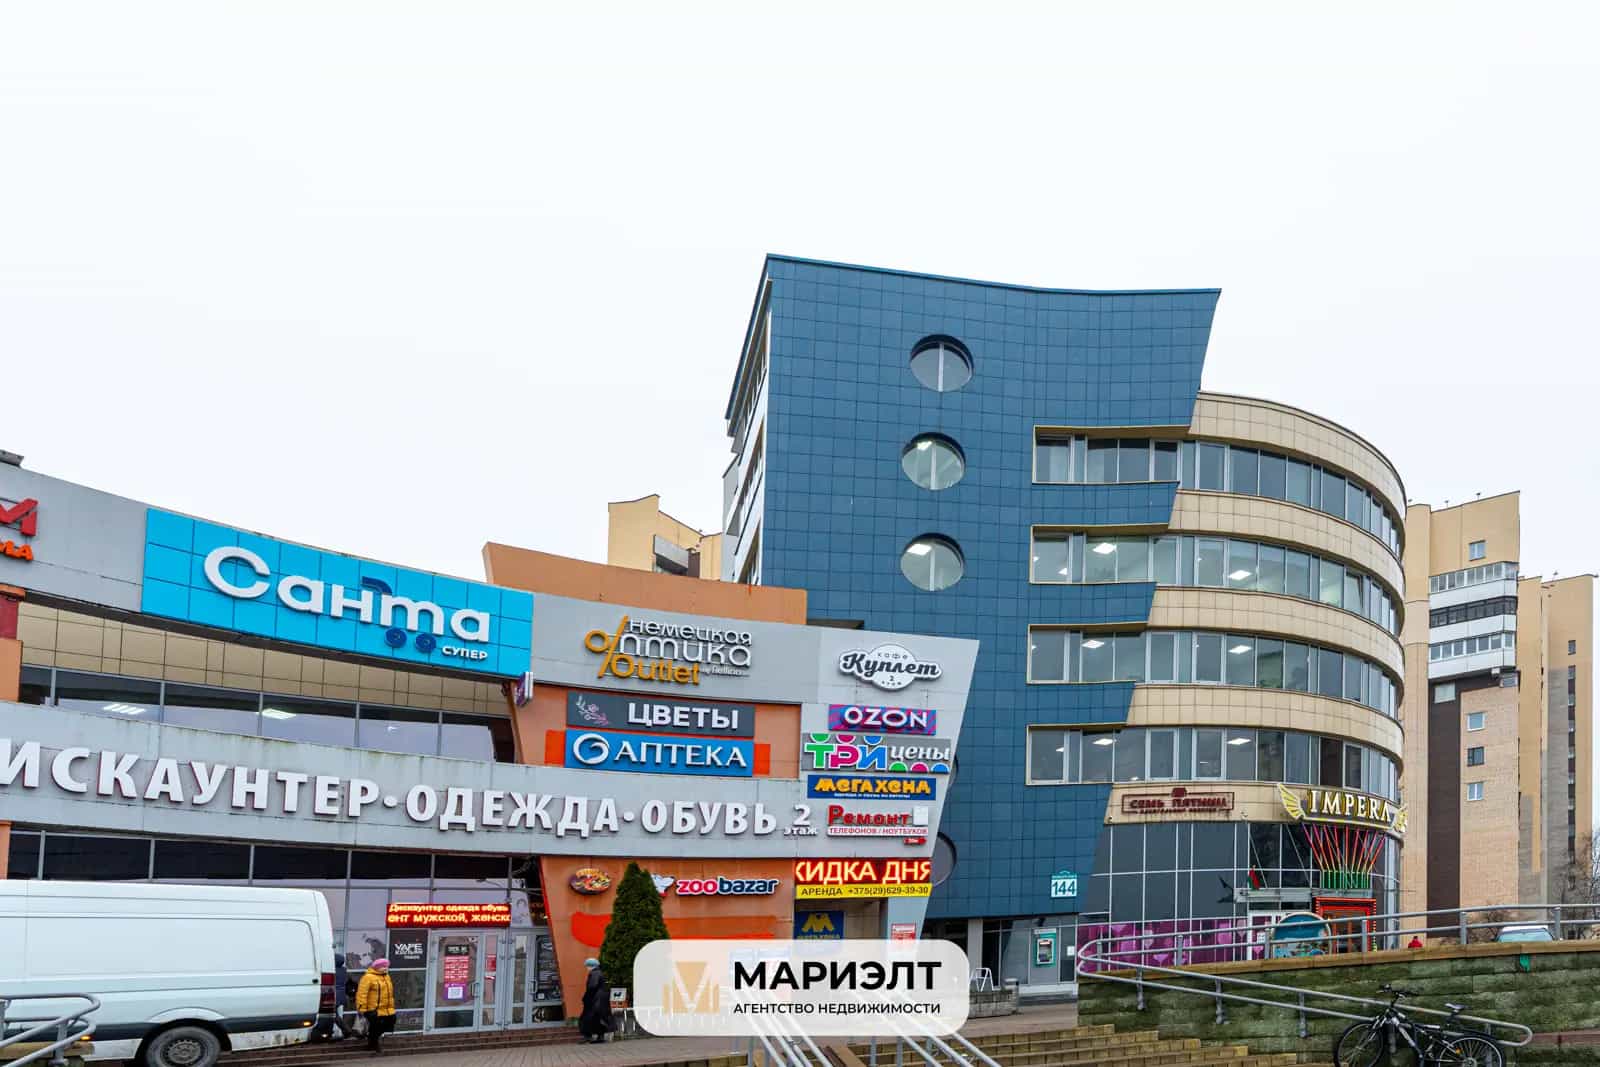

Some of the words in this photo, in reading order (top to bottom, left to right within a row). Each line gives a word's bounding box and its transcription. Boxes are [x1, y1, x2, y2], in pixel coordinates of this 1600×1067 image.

[204, 546, 490, 643] Санта
[842, 653, 939, 678] Куплет
[627, 702, 739, 729] ЦВЕТЫ
[844, 707, 928, 728] OZON
[614, 740, 747, 768] АПТЕКА
[406, 784, 620, 838] ОДЕЖДА
[641, 799, 777, 835] ОБУВЬ
[793, 804, 811, 826] 2
[827, 805, 910, 826] Ремонт
[1307, 790, 1391, 822] IMPERA
[677, 877, 778, 894] zoobazar
[801, 887, 843, 896] АРЕНДА
[1052, 880, 1075, 896] 144
